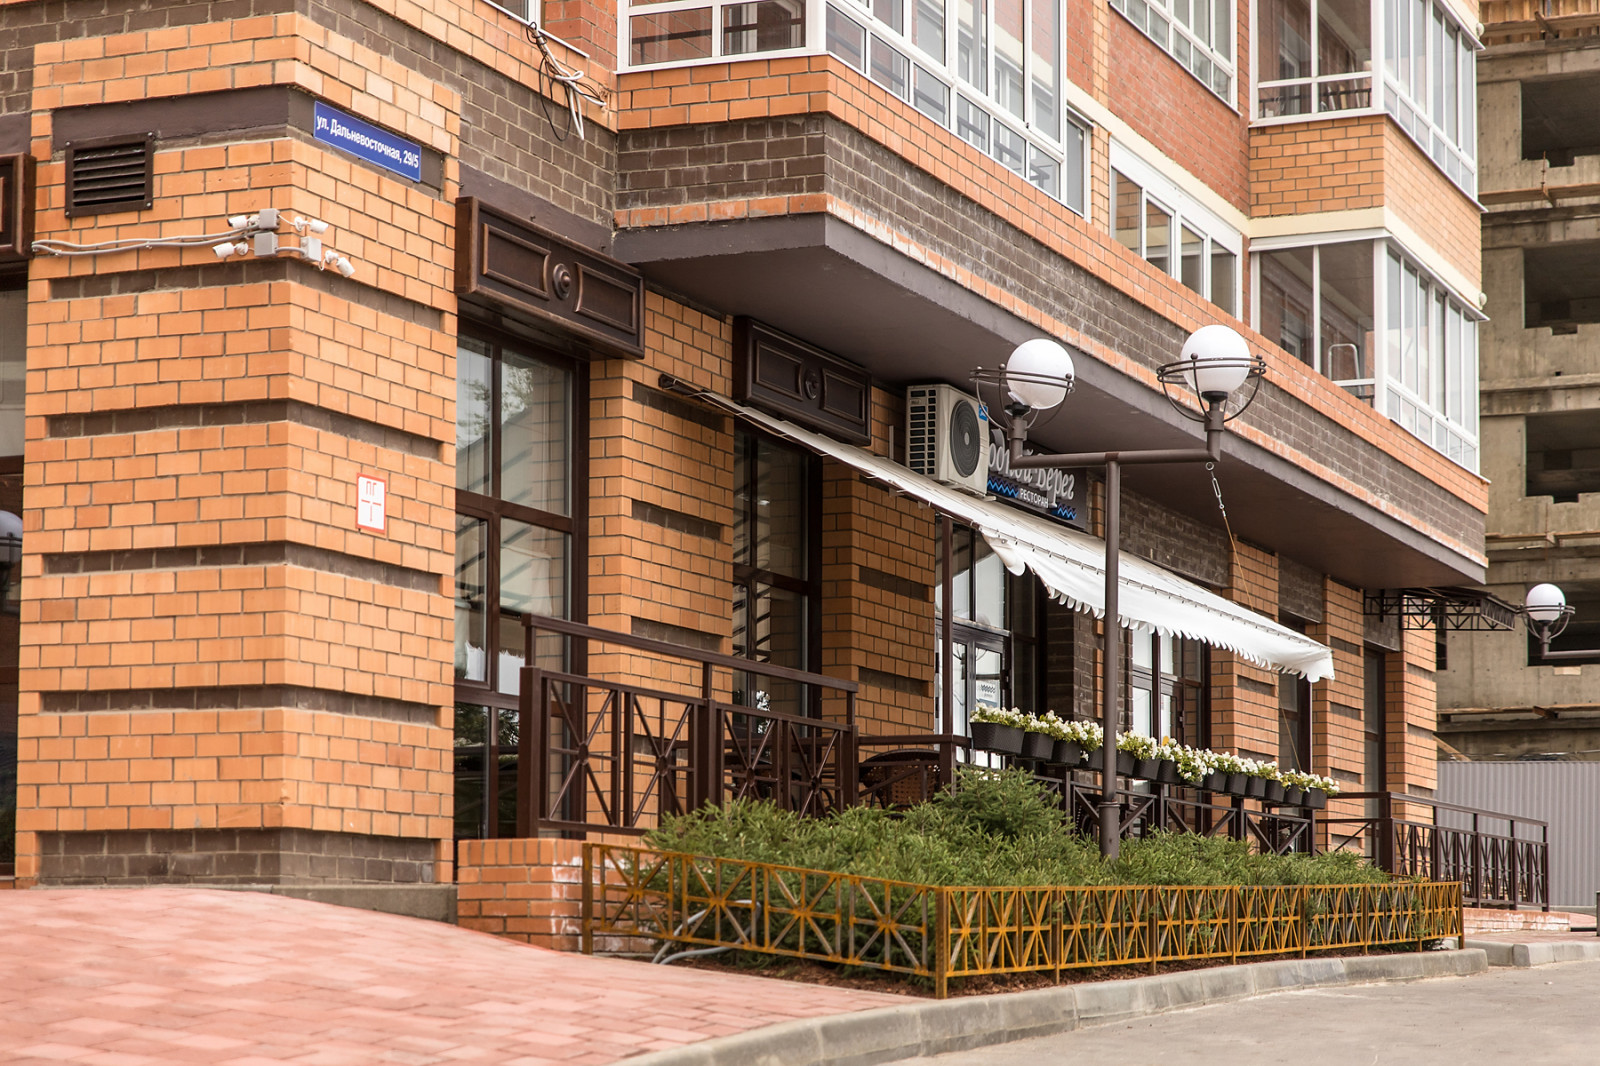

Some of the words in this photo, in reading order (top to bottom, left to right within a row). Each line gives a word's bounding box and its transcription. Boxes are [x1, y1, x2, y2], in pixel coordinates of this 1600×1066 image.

[316, 115, 330, 130] ул.
[330, 118, 402, 163] Дальневосточная,
[403, 150, 419, 168] 29/5
[366, 480, 377, 497] ПГ
[1019, 488, 1049, 509] РЕСТОРАН
[1036, 453, 1075, 508] Берег
